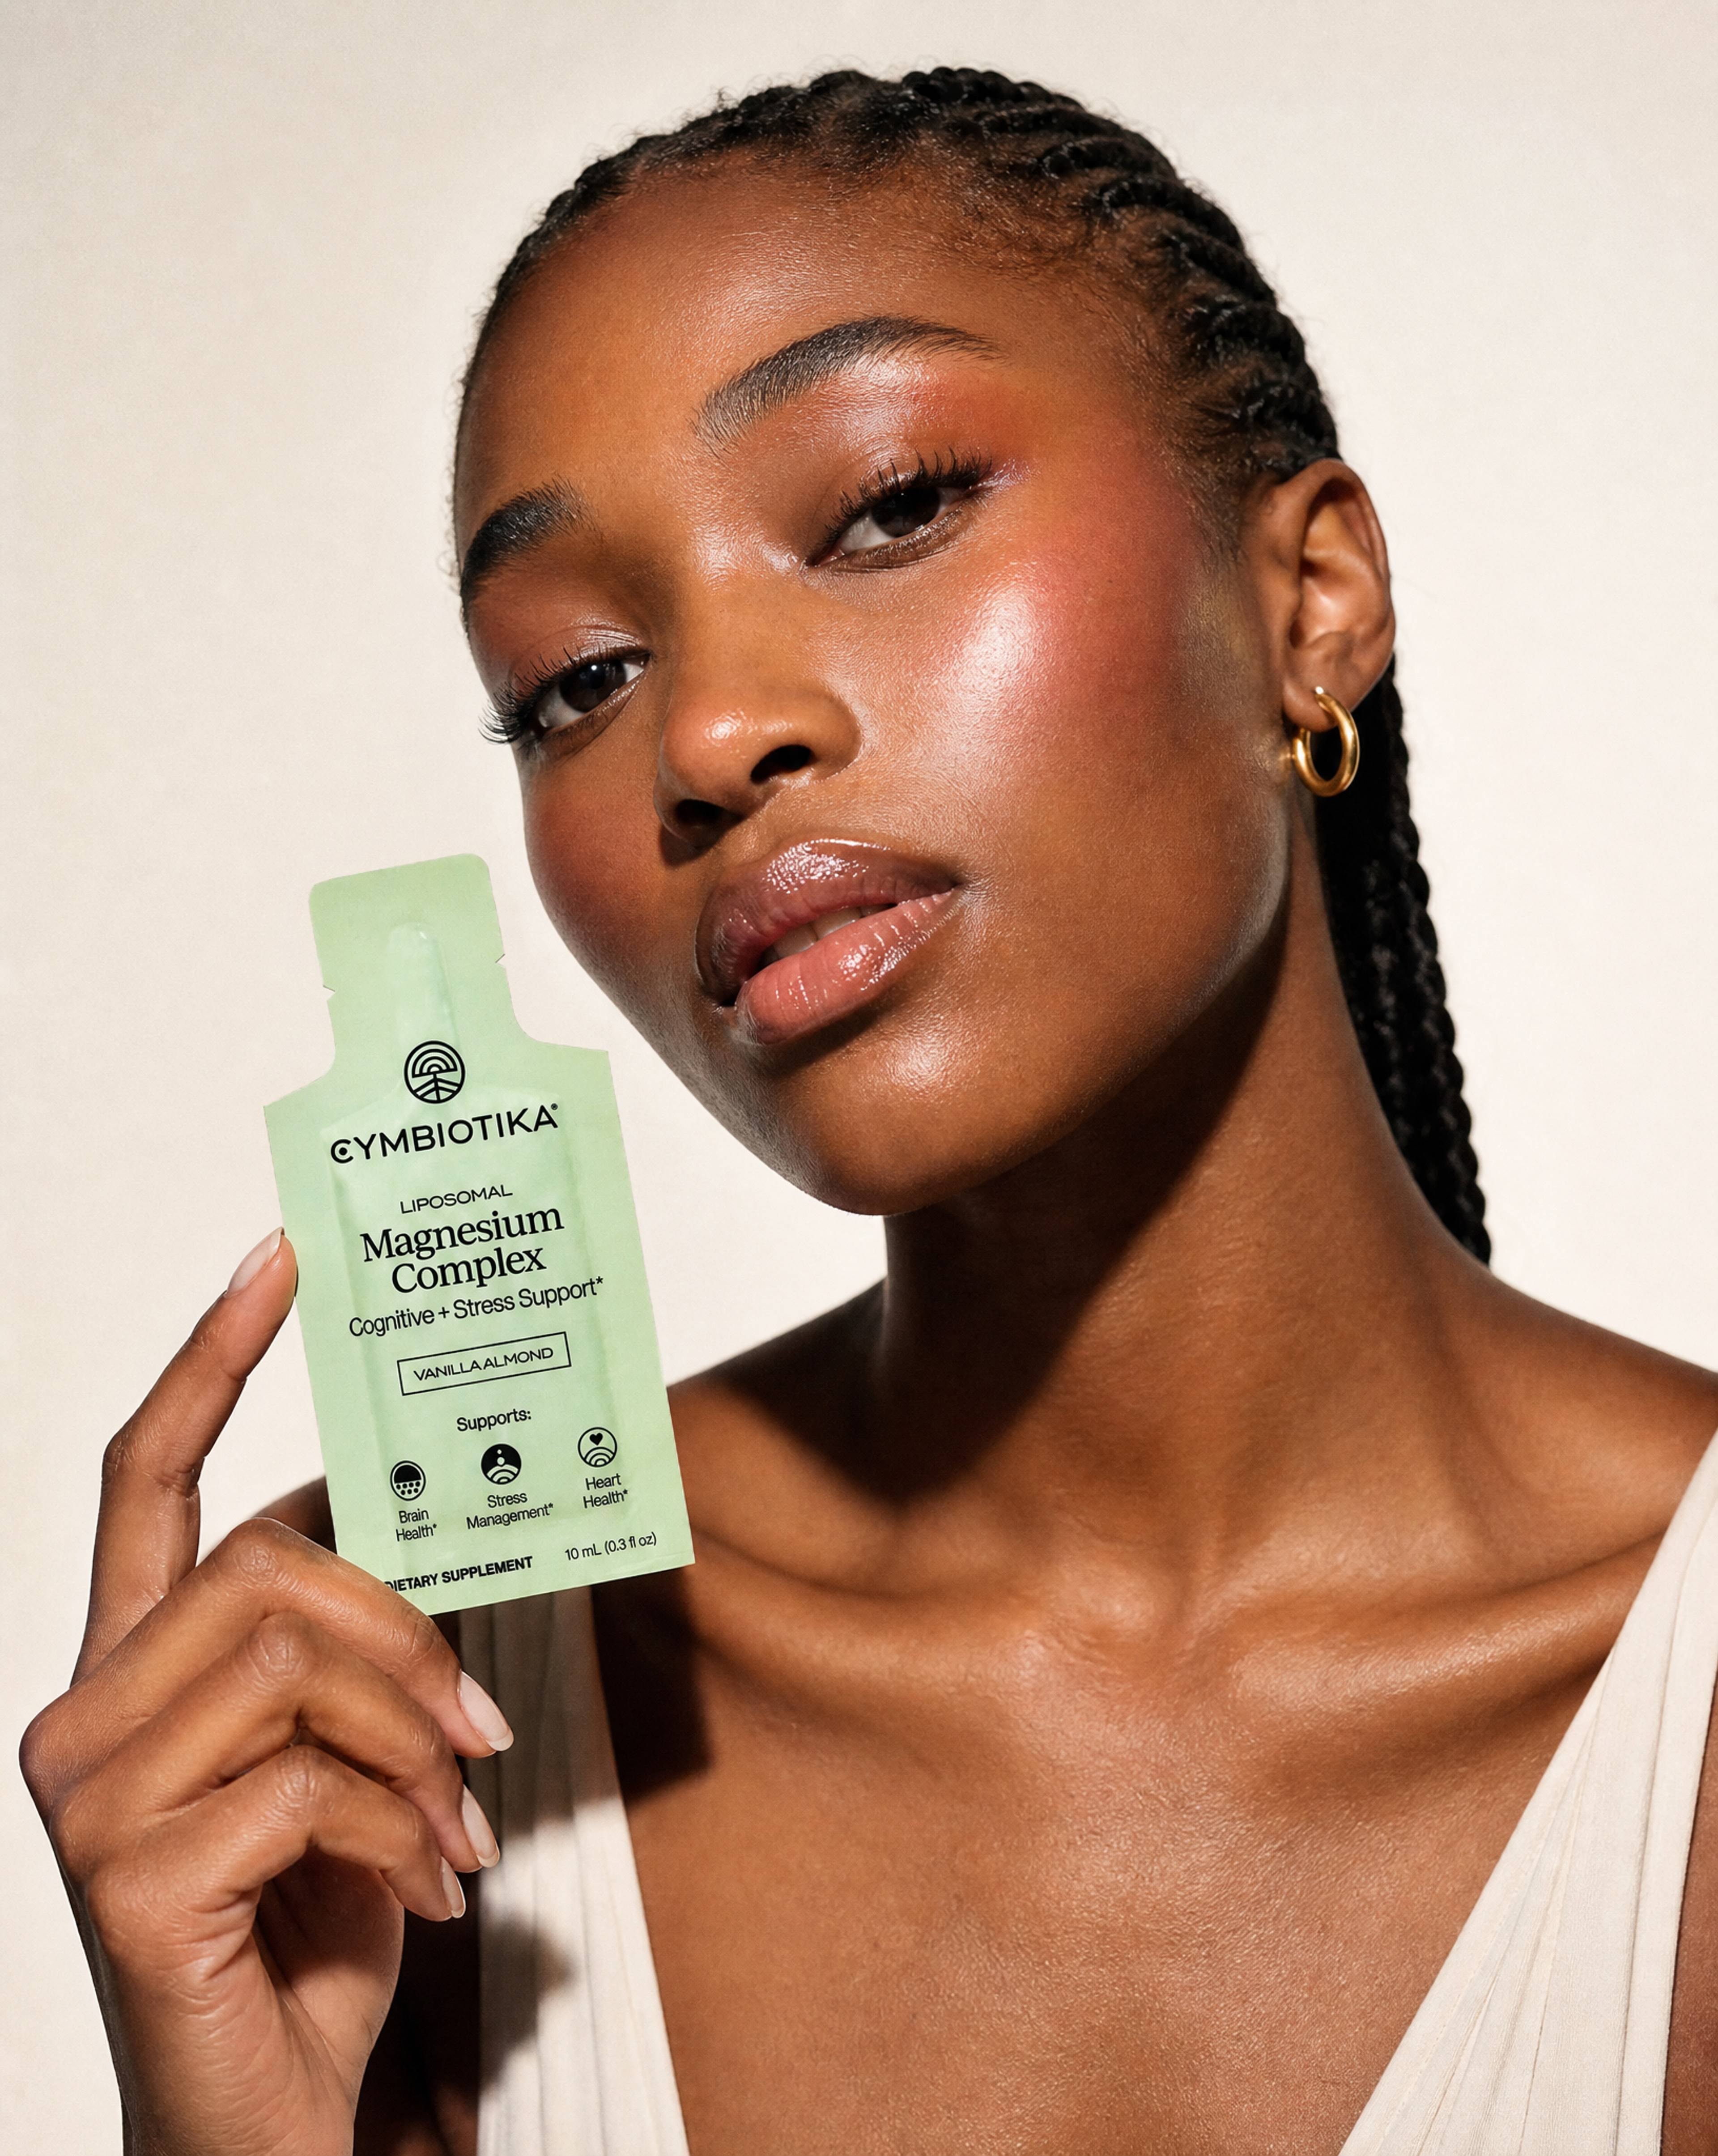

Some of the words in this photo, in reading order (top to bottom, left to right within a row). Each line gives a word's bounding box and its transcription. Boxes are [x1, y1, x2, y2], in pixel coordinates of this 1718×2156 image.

[400, 1184, 514, 1215] LIPOSOMAL
[359, 1208, 565, 1262] Magnesium
[391, 1246, 548, 1294] Complex
[349, 1308, 435, 1337] Cognitive
[453, 1295, 516, 1319] Stress
[413, 1359, 483, 1382] VANILLA
[483, 1347, 554, 1370] ALMOND
[456, 1408, 532, 1432] Supports:
[585, 1472, 622, 1491] Heart
[486, 1492, 528, 1509] Stress
[398, 1508, 430, 1524] Brain
[565, 1547, 579, 1561] 10
[581, 1543, 603, 1558] mL
[604, 1538, 627, 1556] (0.3
[627, 1535, 637, 1549] fl
[638, 1531, 657, 1547] oz)
[441, 1555, 533, 1584] SUPPLEMENT
